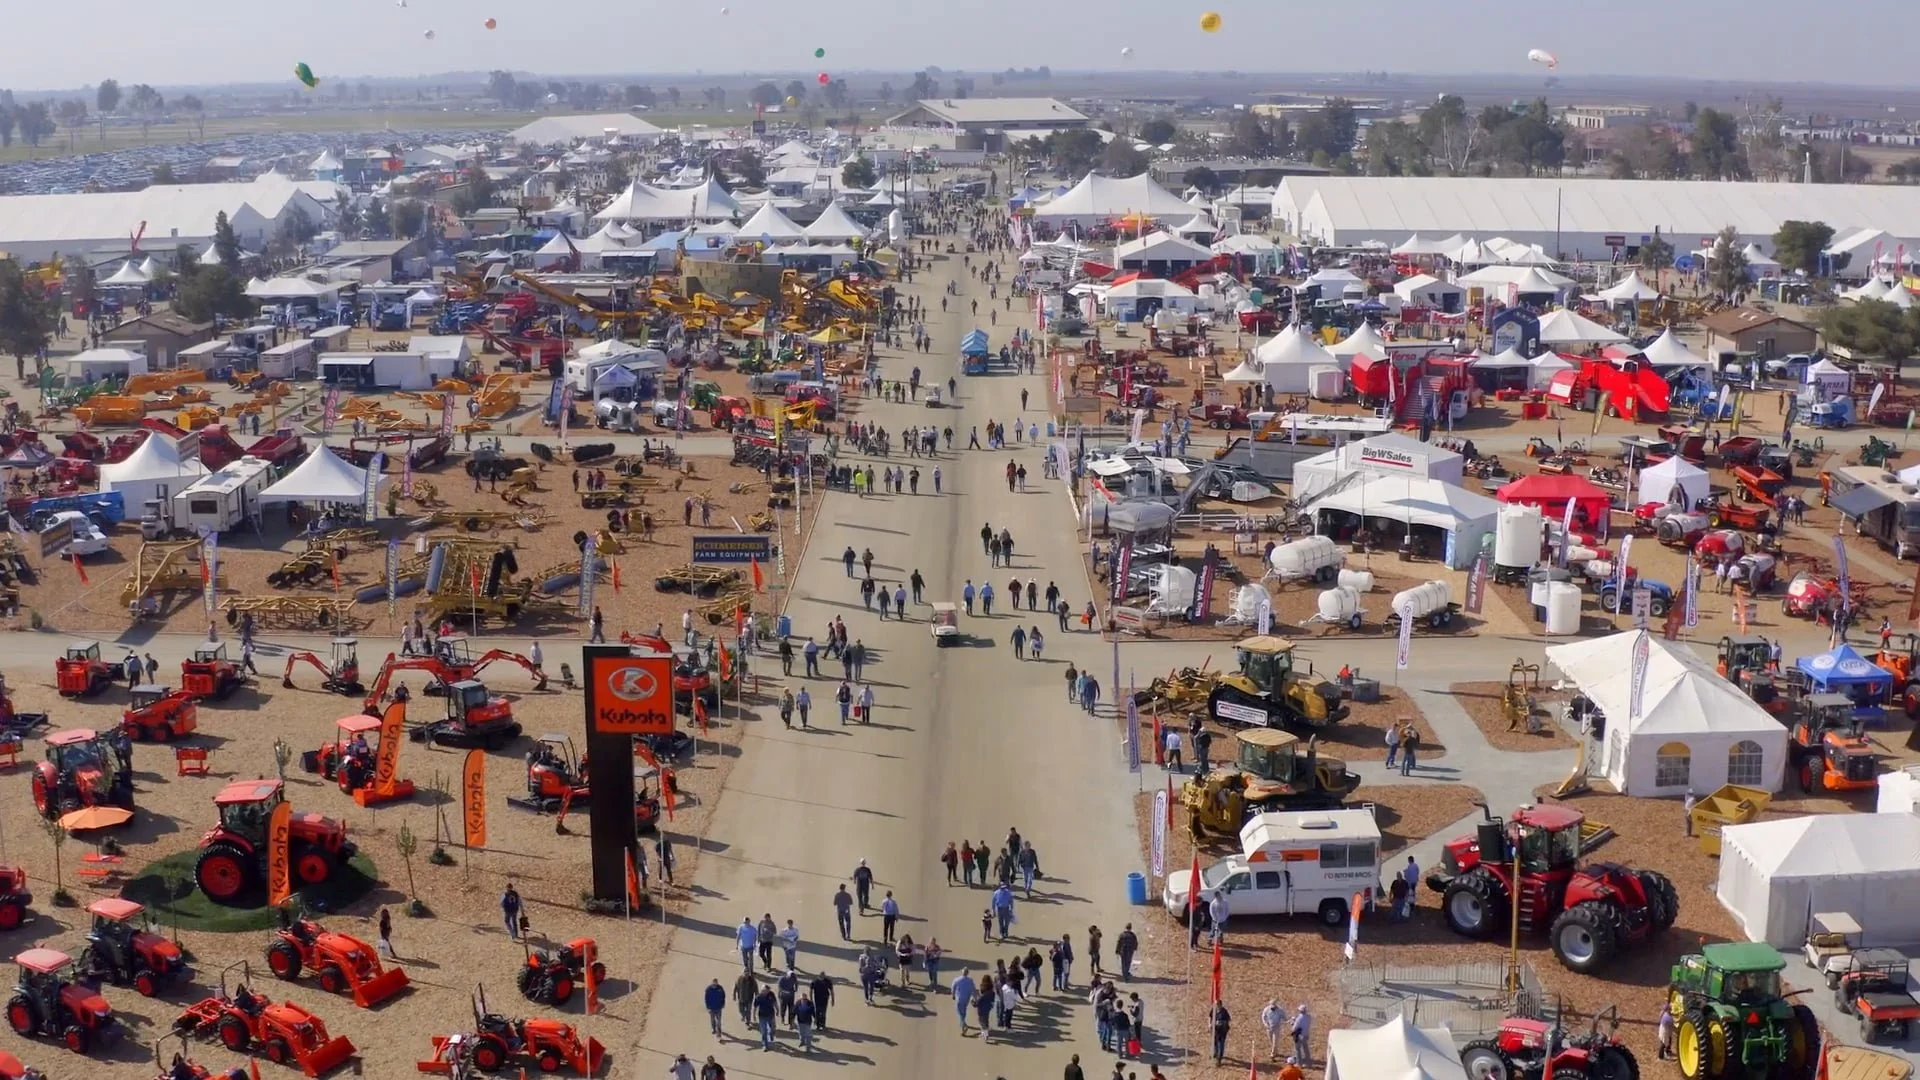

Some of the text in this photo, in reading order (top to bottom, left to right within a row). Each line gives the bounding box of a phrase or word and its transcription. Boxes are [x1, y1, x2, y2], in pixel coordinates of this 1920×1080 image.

[600, 707, 667, 725] Kubota
[379, 724, 399, 783] Kubota
[467, 772, 483, 834] Kubota
[272, 825, 287, 893] Kubota
